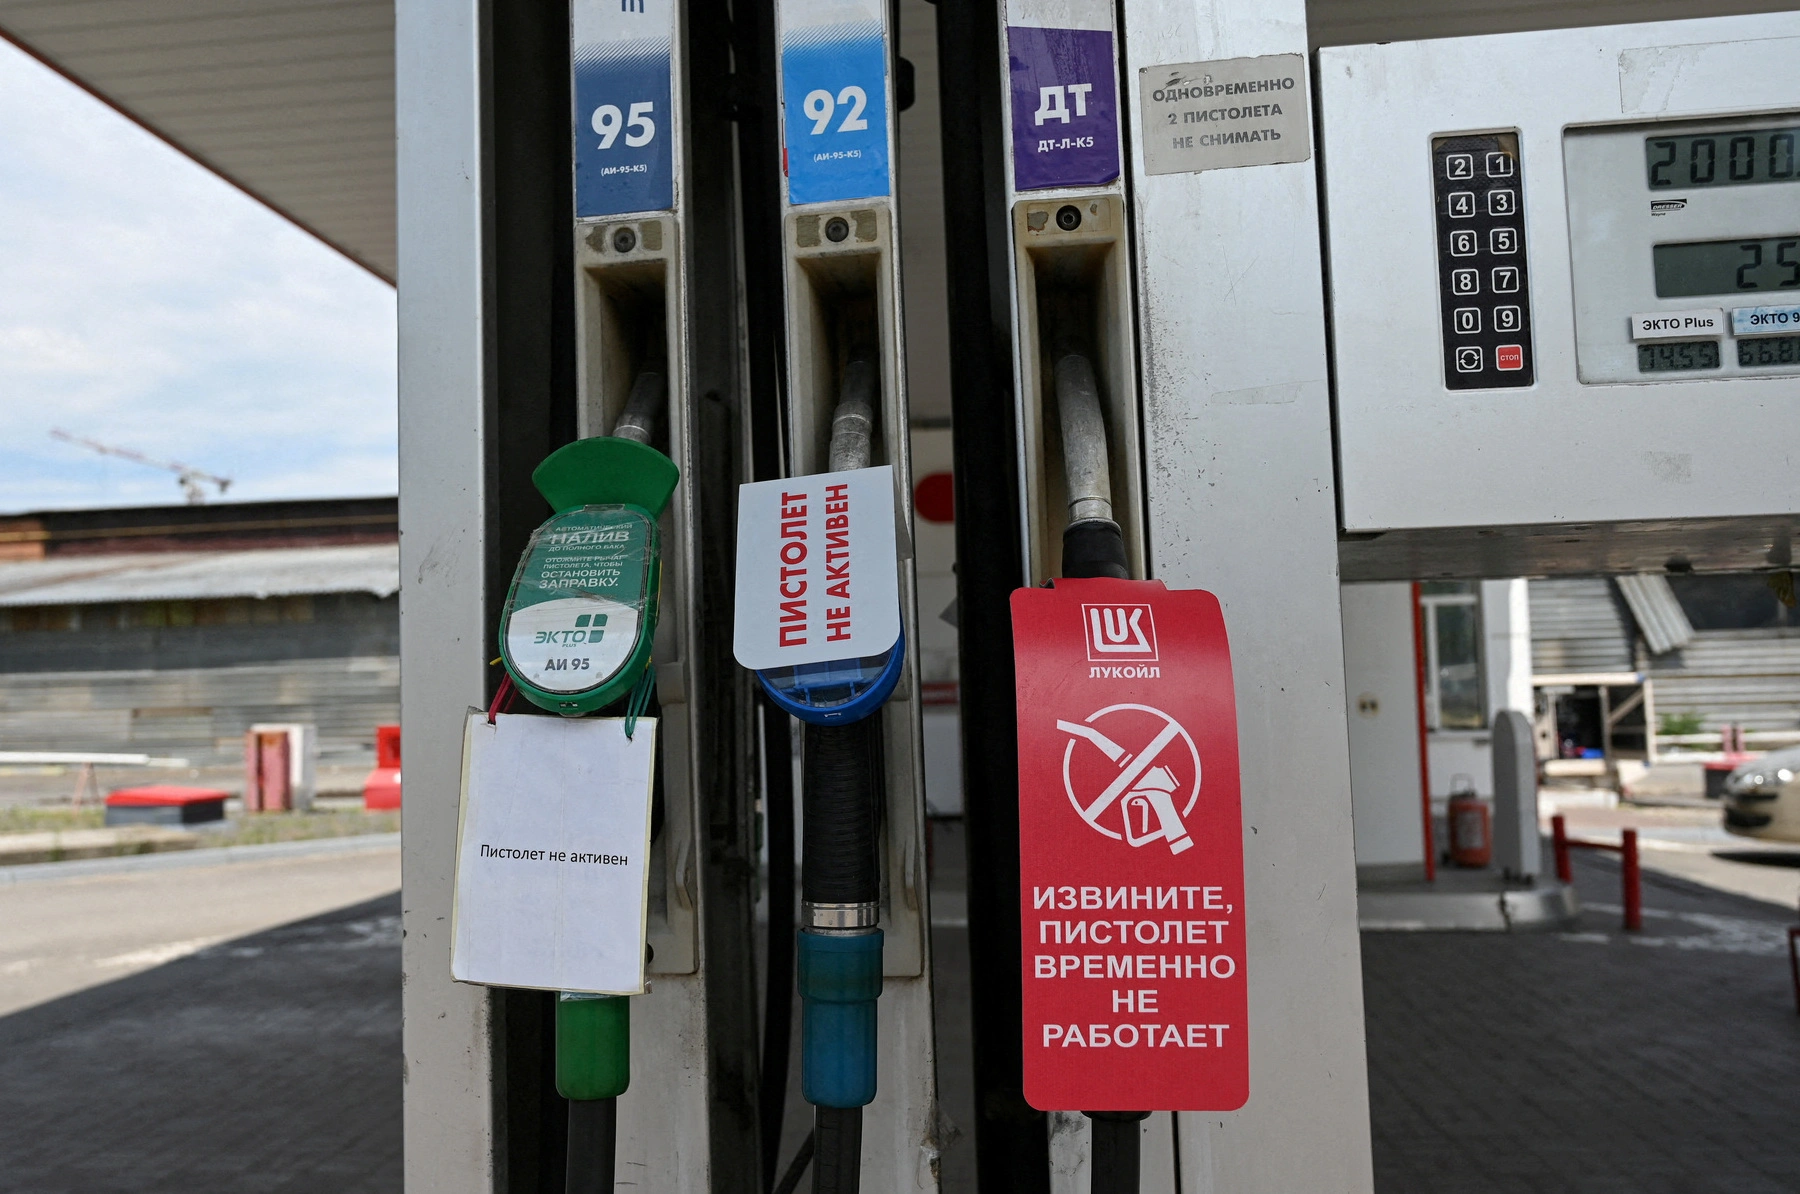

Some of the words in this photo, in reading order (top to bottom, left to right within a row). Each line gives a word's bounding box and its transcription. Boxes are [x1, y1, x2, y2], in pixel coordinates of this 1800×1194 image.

[1152, 77, 1295, 103] ОДНОВРЕМЕННО
[803, 85, 868, 135] 92
[1034, 83, 1092, 126] ДТ
[1168, 113, 1178, 125] 2
[1183, 103, 1283, 124] ПИСТОЛЕТА
[591, 101, 656, 150] 95
[1037, 137, 1094, 153] ДТ-Л-К5
[1172, 136, 1194, 150] НЕ
[1199, 128, 1281, 147] СНИМАТЬ
[813, 149, 862, 163] (АИ-95-К5)
[1495, 155, 1505, 173] 1
[600, 164, 648, 177] (АИ-95-К5)
[1454, 158, 1467, 176] 2
[1455, 196, 1469, 214] 4
[1496, 194, 1508, 212] 3
[1457, 234, 1470, 252] 6
[1498, 232, 1510, 250] 5
[1460, 273, 1472, 291] 8
[1499, 271, 1512, 289] 7
[1461, 312, 1474, 330] 0
[1501, 310, 1514, 328] 9
[1642, 318, 1680, 330] ЭКТО
[1684, 317, 1714, 329] Plus
[1750, 312, 1789, 325] ЭКТО
[549, 531, 630, 544] НАЛИВ
[825, 483, 850, 600] АКТИВЕН
[541, 569, 620, 578] ОСТАНОВИТЬ
[779, 491, 808, 648] ПИСТОЛЕТ
[538, 577, 619, 589] ЗАПРАВКУ.
[826, 606, 851, 642] НЕ
[534, 629, 587, 644] ЭКТО
[544, 658, 568, 671] АИ
[571, 657, 590, 670] 95
[1088, 664, 1161, 679] ЛУКОЙЛ
[480, 844, 546, 861] Пистолет
[549, 851, 566, 862] не
[570, 852, 628, 866] активен
[1033, 886, 1233, 914] ИЗВИНИТЕ,
[1039, 920, 1229, 944] ПИСТОЛЕТ
[1034, 954, 1236, 979] ВРЕМЕННО
[1112, 989, 1159, 1013] НЕ
[1042, 1023, 1230, 1048] РАБОТАЕТ
